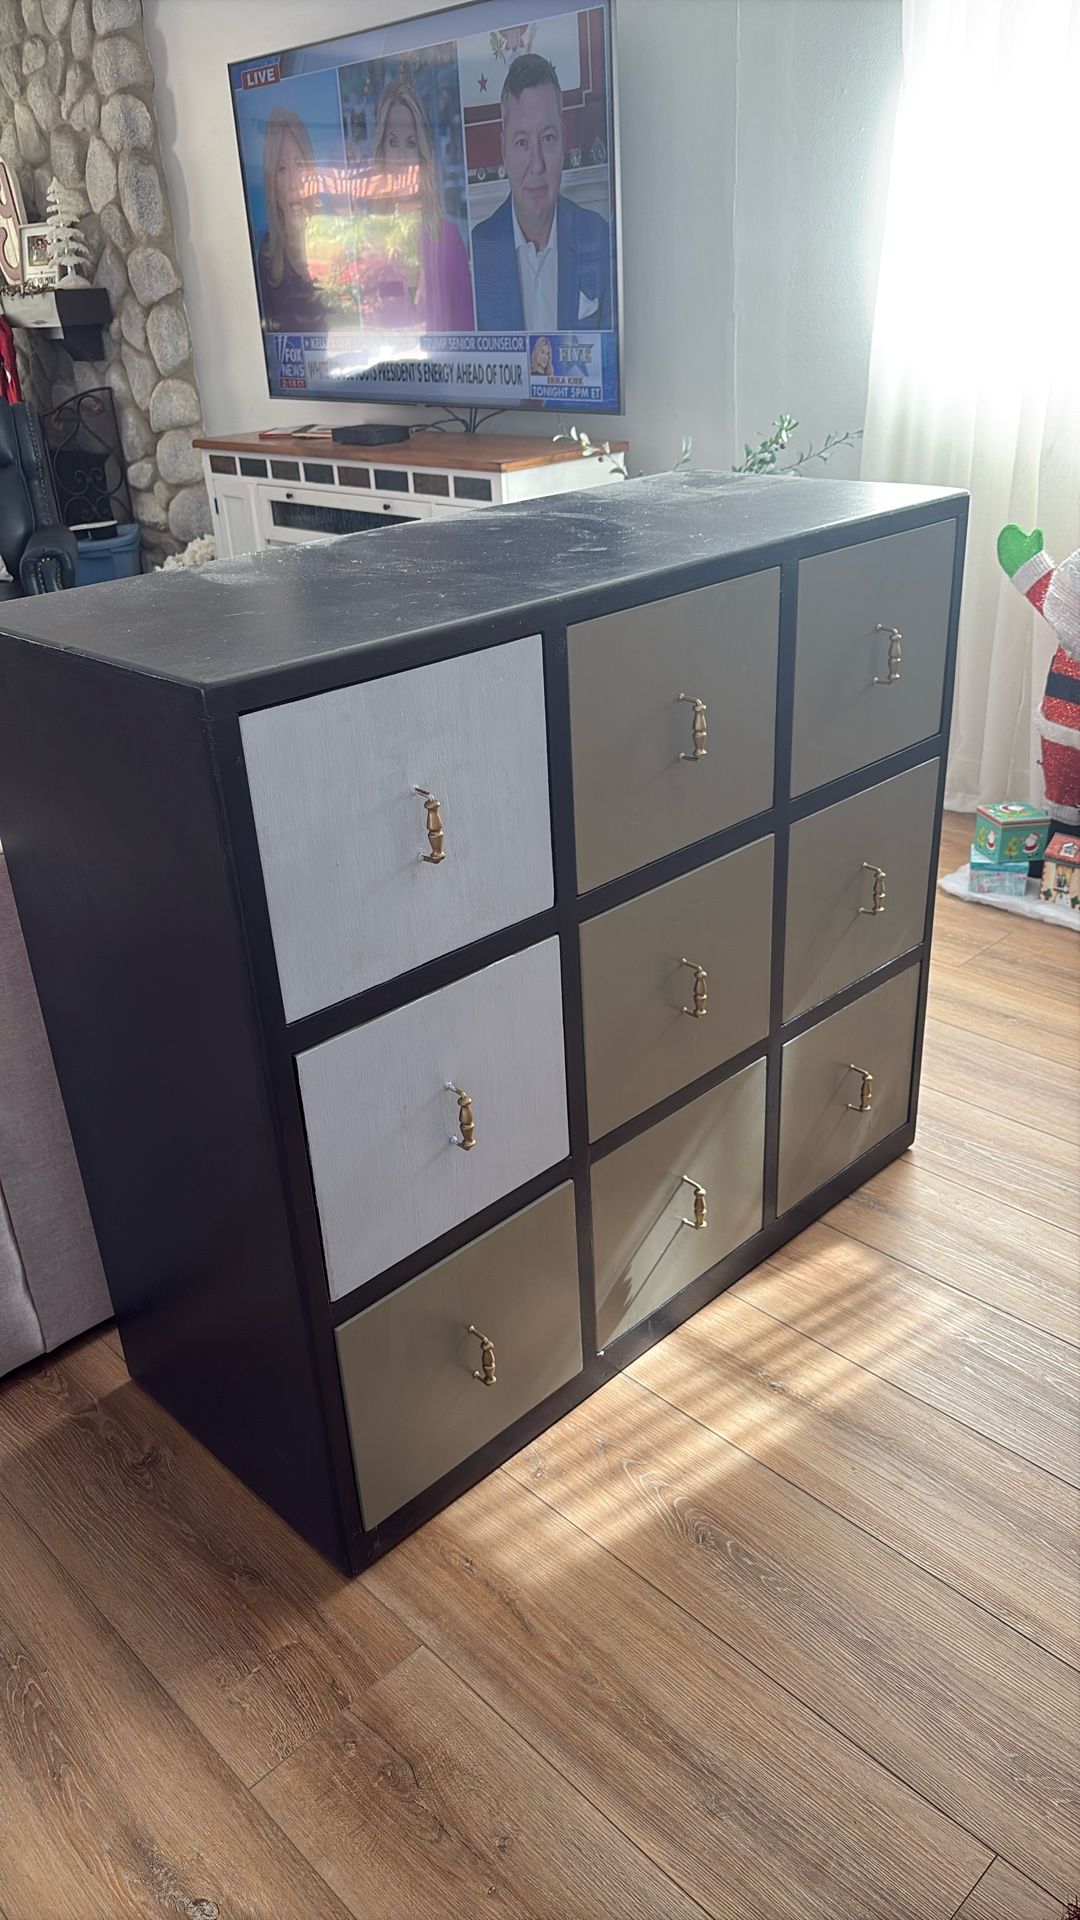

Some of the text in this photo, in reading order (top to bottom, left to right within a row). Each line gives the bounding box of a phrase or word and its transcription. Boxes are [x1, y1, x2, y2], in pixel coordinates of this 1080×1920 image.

[246, 68, 275, 86] LIVE
[448, 337, 476, 350] SENIOR
[476, 337, 524, 351] COUNSELOR
[285, 348, 303, 362] FOX
[282, 364, 304, 378] NEWS
[423, 363, 454, 383] ENERGY
[456, 363, 485, 384] AHEAD
[485, 363, 498, 384] OF
[498, 364, 523, 385] TOUR
[532, 386, 600, 399] TONIGHT 5PM ET
